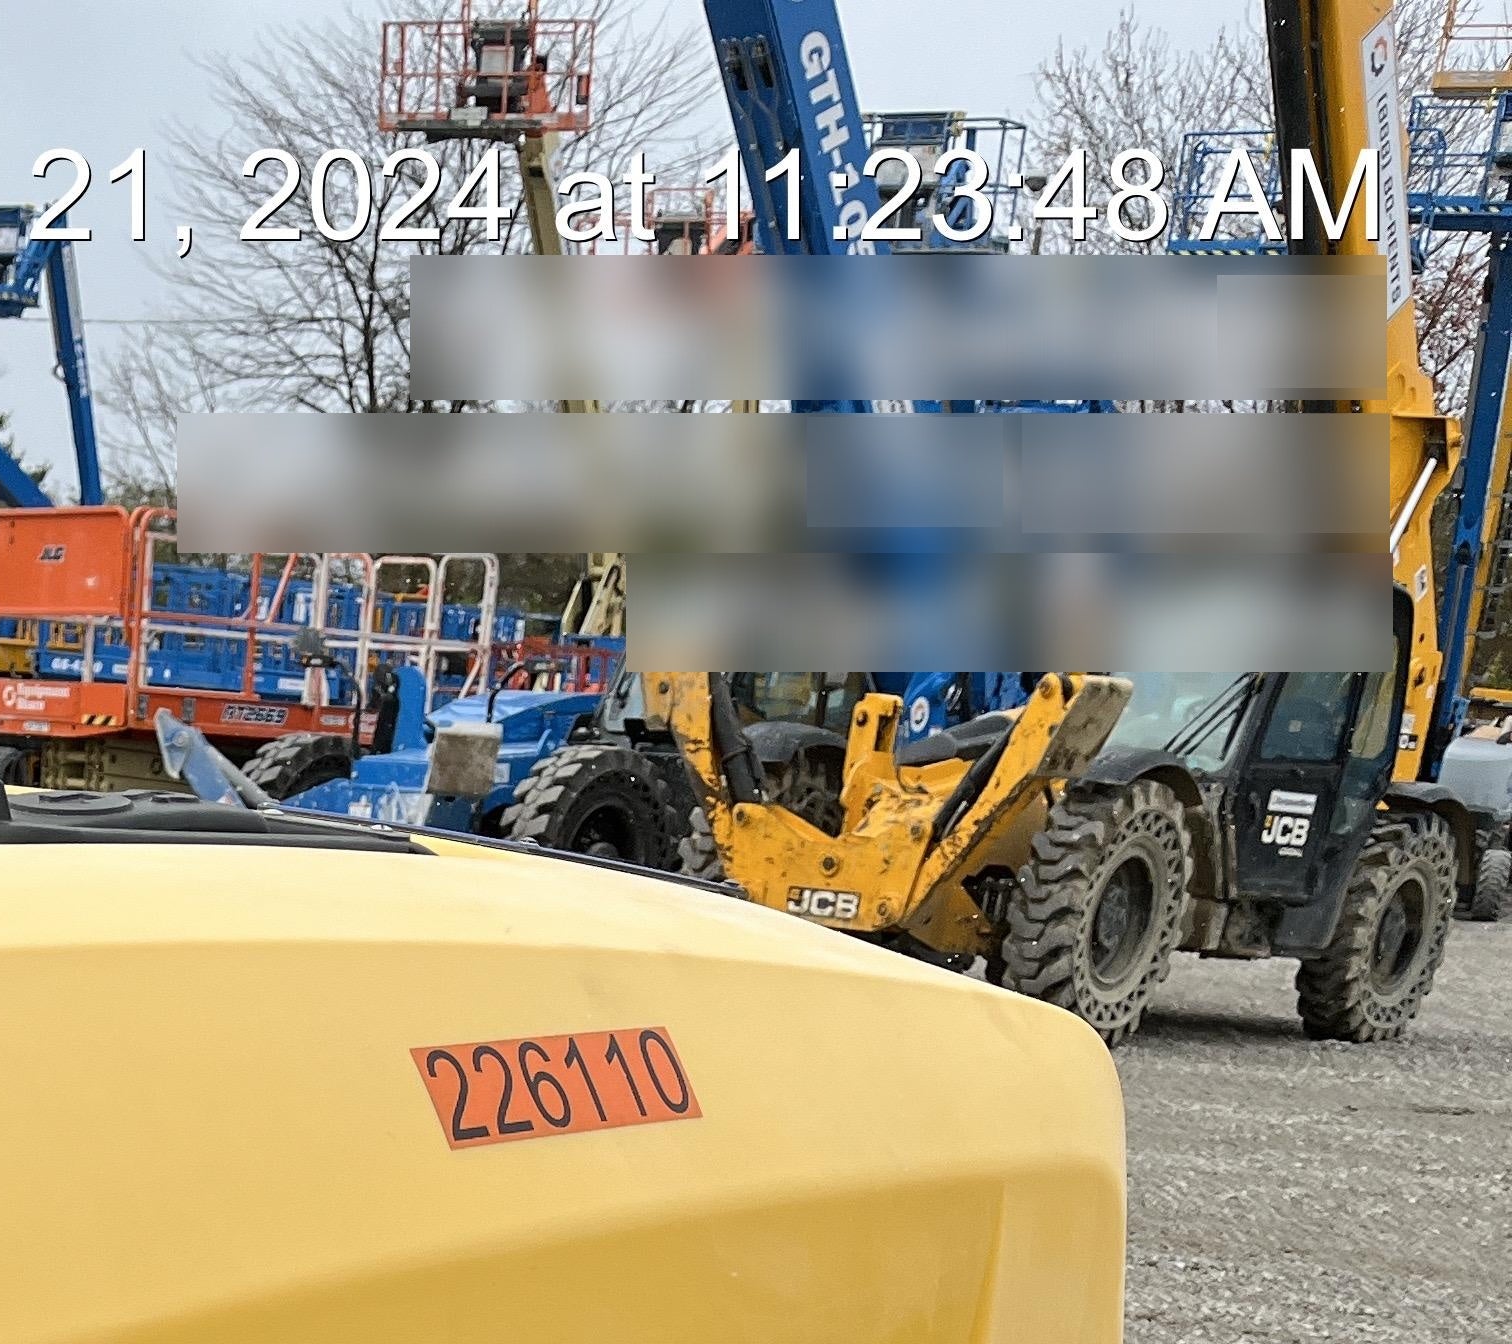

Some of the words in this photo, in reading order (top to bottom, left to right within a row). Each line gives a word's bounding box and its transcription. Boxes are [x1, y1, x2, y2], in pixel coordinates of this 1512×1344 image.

[1261, 815, 1311, 847] JCB
[788, 889, 861, 920] JCB
[426, 1029, 690, 1141] 226110
